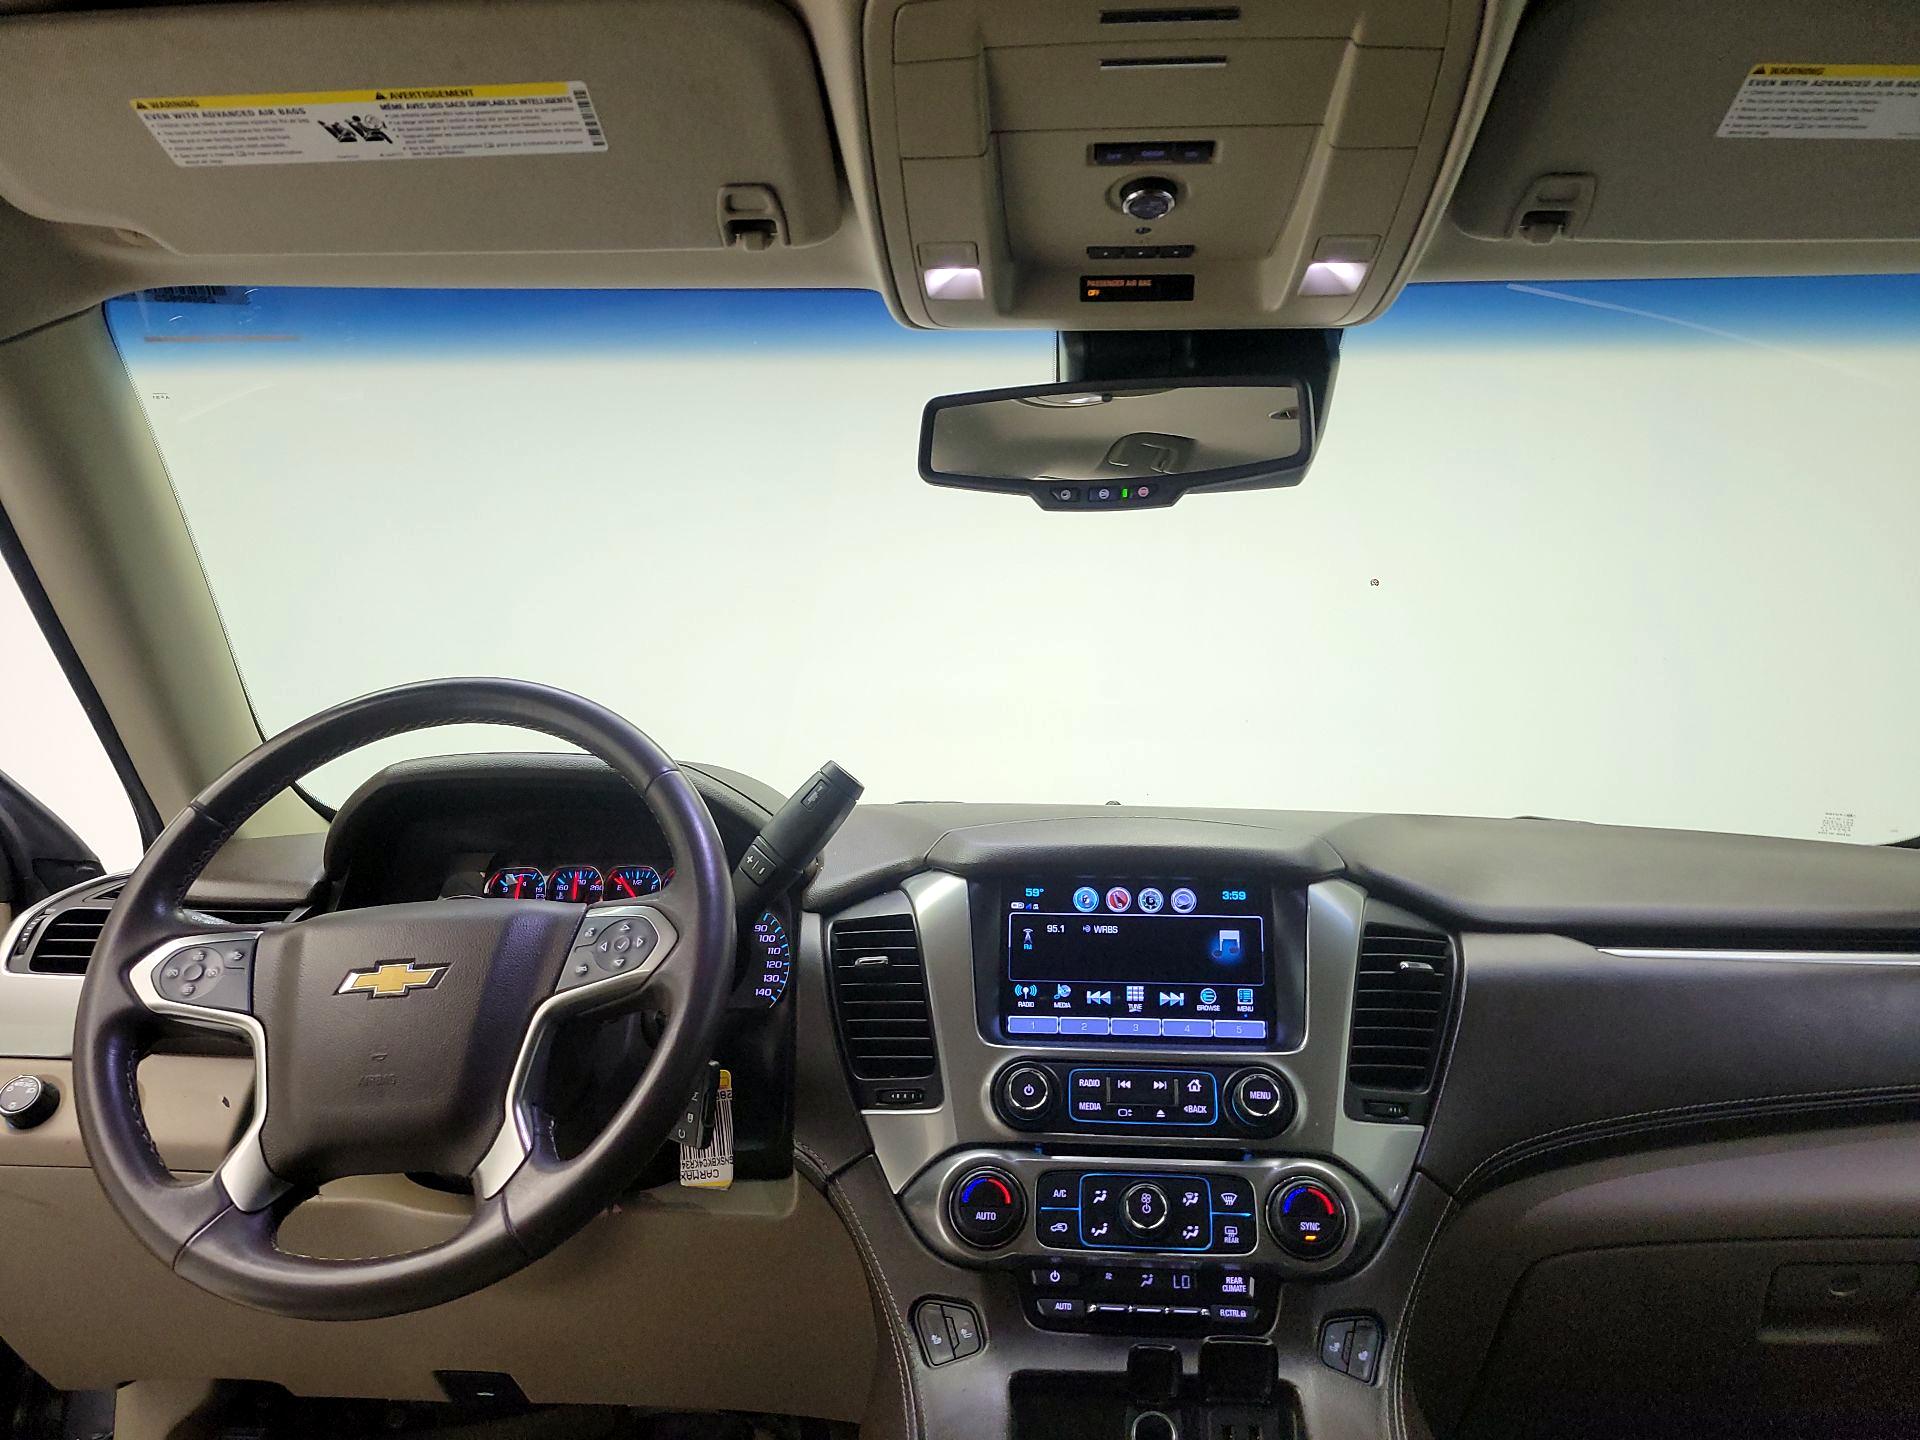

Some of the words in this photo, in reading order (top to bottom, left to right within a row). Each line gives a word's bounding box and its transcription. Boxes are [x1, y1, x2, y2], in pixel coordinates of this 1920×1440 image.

[150, 99, 200, 109] WARNING
[1222, 890, 1247, 901] 3:59
[754, 924, 768, 933] 90
[1046, 924, 1065, 933] 95.1
[1093, 925, 1119, 934] WRBS
[759, 934, 776, 943] 100
[767, 947, 781, 955] 110
[766, 960, 783, 969] 120
[763, 974, 780, 983] 130
[755, 988, 772, 996] 140
[1196, 1004, 1221, 1012] BROWSE
[1080, 1022, 1088, 1031] 2
[1132, 1023, 1140, 1032] 3
[1184, 1024, 1190, 1033] 4
[1236, 1025, 1243, 1034] 5
[1078, 1078, 1100, 1088] RADIO
[1249, 1090, 1271, 1101] MENU
[1078, 1101, 1102, 1111] MEDIA
[1187, 1104, 1208, 1115] BACK
[1052, 1188, 1068, 1198] A/C
[975, 1211, 997, 1221] AUTO
[1299, 1221, 1321, 1231] SYNC
[1223, 1236, 1240, 1244] REAR
[1225, 1276, 1244, 1285] REAR
[1221, 1284, 1248, 1293] CLIMATE
[1054, 1302, 1073, 1311] AUTO
